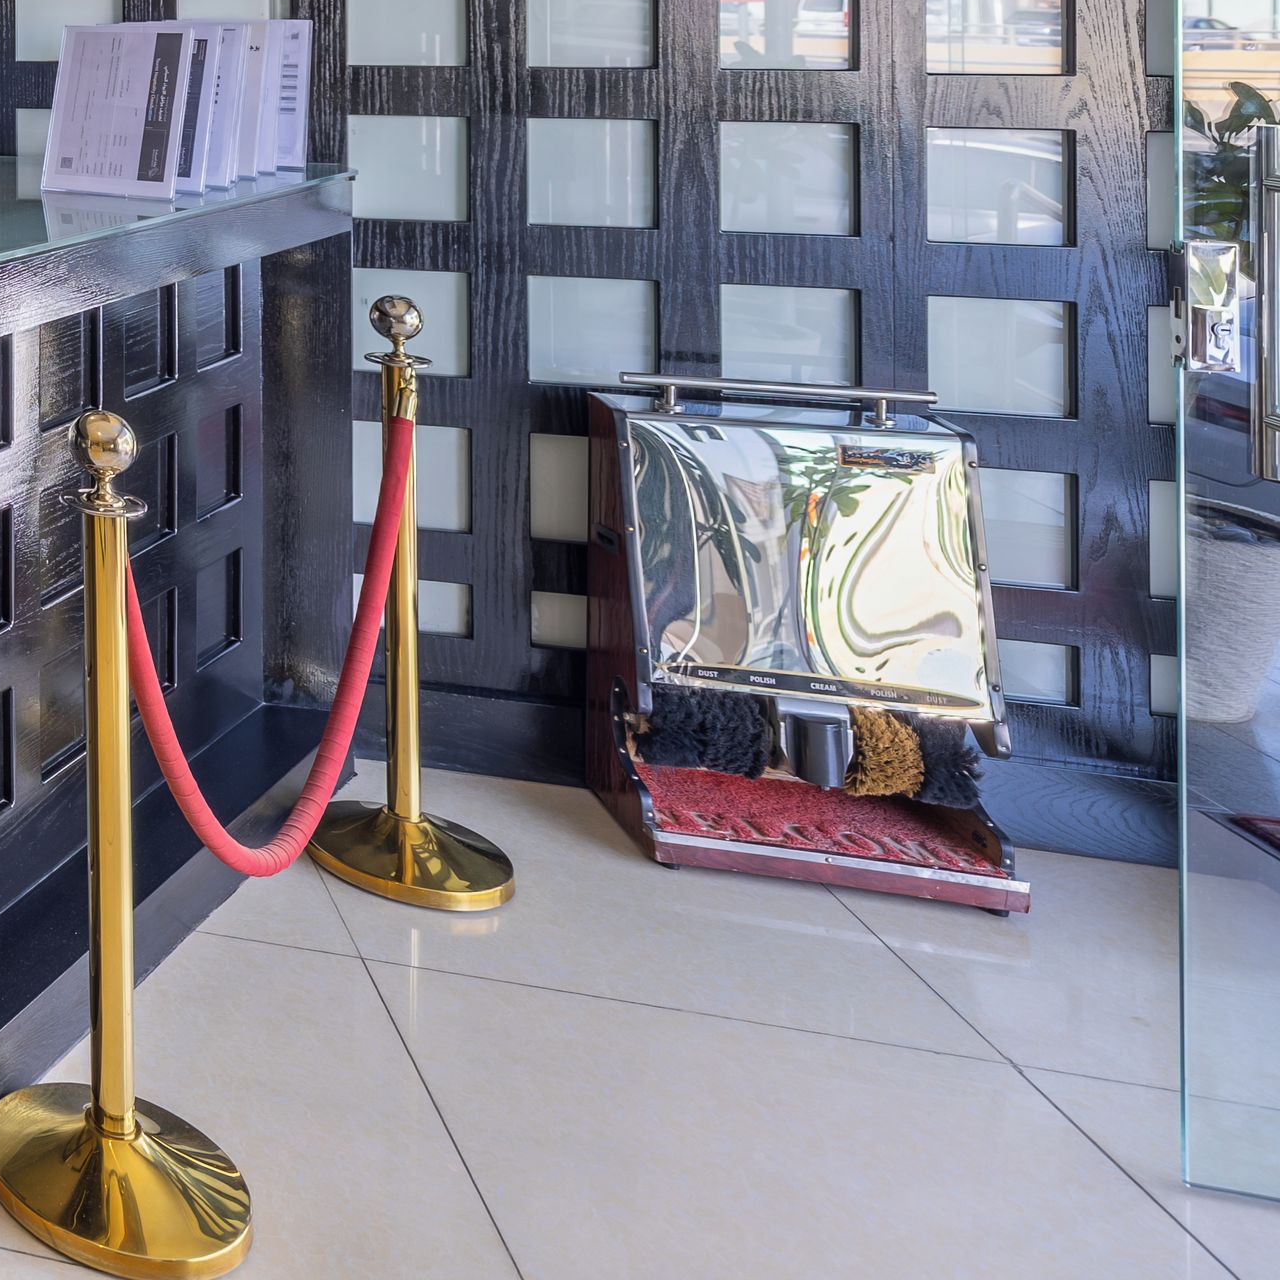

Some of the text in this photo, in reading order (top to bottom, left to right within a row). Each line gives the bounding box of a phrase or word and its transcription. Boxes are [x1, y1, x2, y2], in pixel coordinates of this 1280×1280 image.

[698, 669, 718, 678] DUST
[749, 675, 776, 685] POLISH
[810, 682, 837, 692] CREAM
[870, 689, 898, 699] POLISH
[926, 695, 947, 705] DUST
